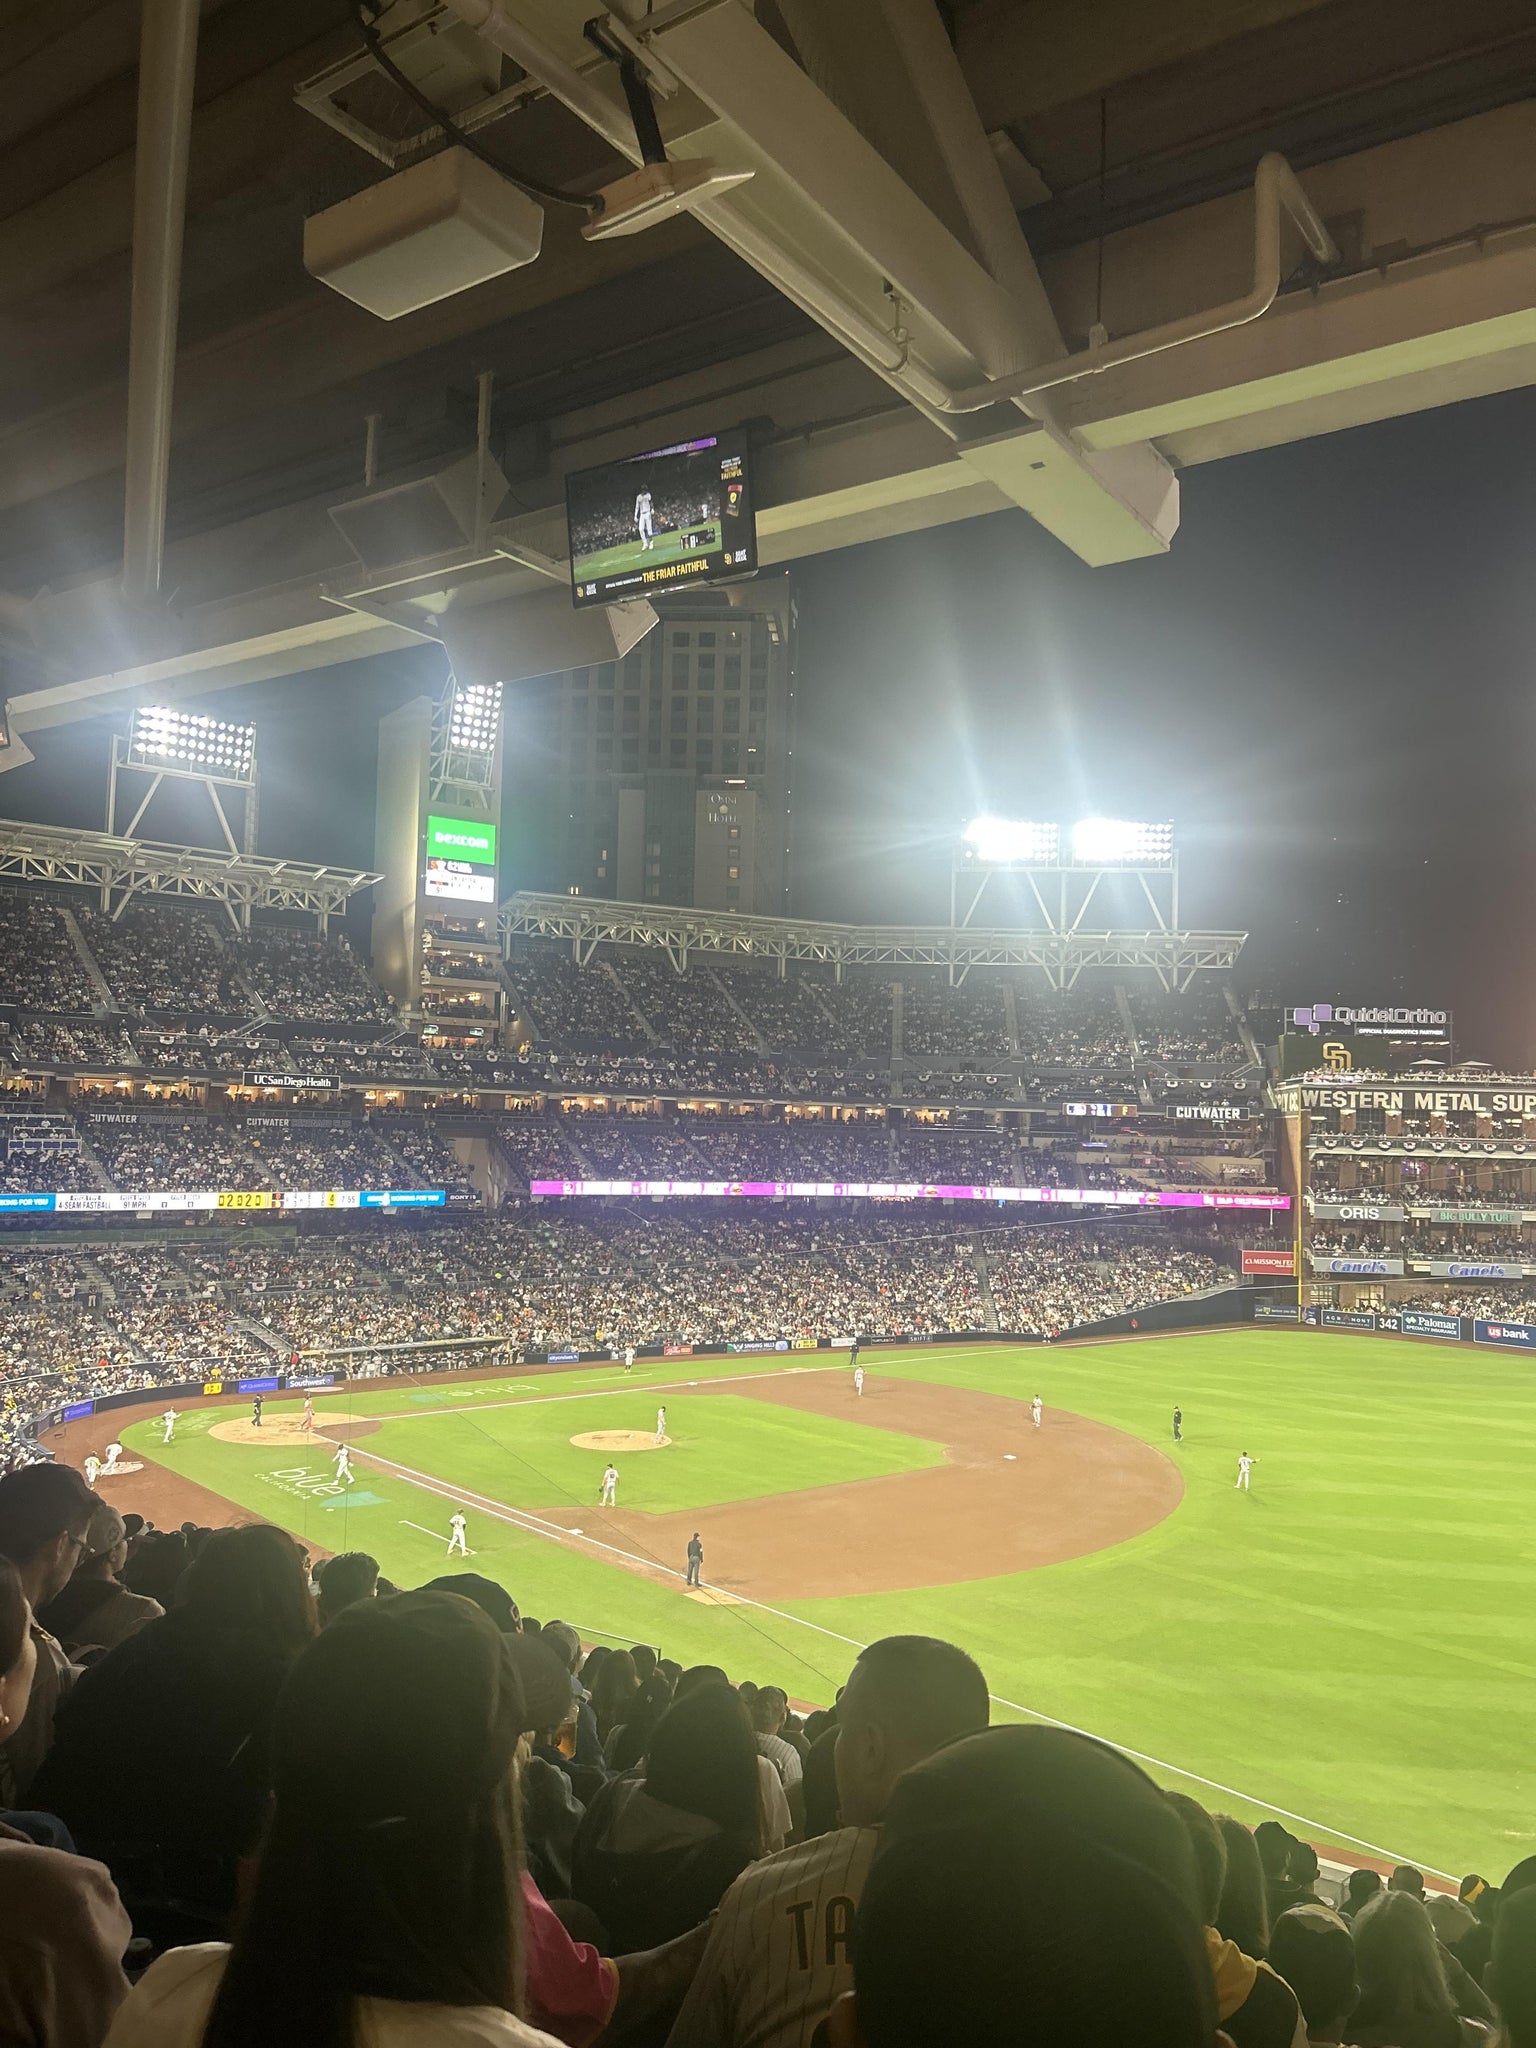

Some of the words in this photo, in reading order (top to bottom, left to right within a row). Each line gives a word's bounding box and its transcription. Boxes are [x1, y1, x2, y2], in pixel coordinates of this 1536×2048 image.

[642, 571, 656, 583] THE
[656, 565, 677, 580] FRIAR
[676, 559, 709, 576] FAITHFUL
[1335, 1007, 1447, 1025] QuidelOrtho
[254, 1074, 268, 1085] UC
[268, 1075, 284, 1086] San
[284, 1076, 306, 1088] Diego
[306, 1077, 331, 1087] Health
[1301, 1089, 1403, 1110] WESTERN
[1415, 1092, 1487, 1112] METAL
[1175, 1107, 1241, 1120] CUTWATER
[246, 1117, 289, 1127] CUTWATER
[58, 1201, 81, 1210] 4-SEAM
[82, 1201, 111, 1209] FASTBALL
[131, 1201, 147, 1209] MPH
[1340, 1207, 1380, 1219] ORIS
[1440, 1212, 1456, 1221] BIG
[1459, 1212, 1487, 1222] BULLY
[1253, 1258, 1281, 1266] MISSION
[1330, 1259, 1388, 1273] Canel's
[1448, 1263, 1506, 1277] Canel's
[1378, 1317, 1398, 1330] 342
[1418, 1316, 1457, 1330] Palomar
[1406, 1325, 1430, 1333] SPECIALTY
[1431, 1327, 1457, 1335] INSURANCE
[1488, 1328, 1501, 1337] us
[1503, 1328, 1529, 1340] bank
[289, 1379, 325, 1388] Southwest
[254, 1473, 311, 1500] CALIFORNIA
[270, 1466, 346, 1496] blue
[786, 1895, 856, 1971] TA
